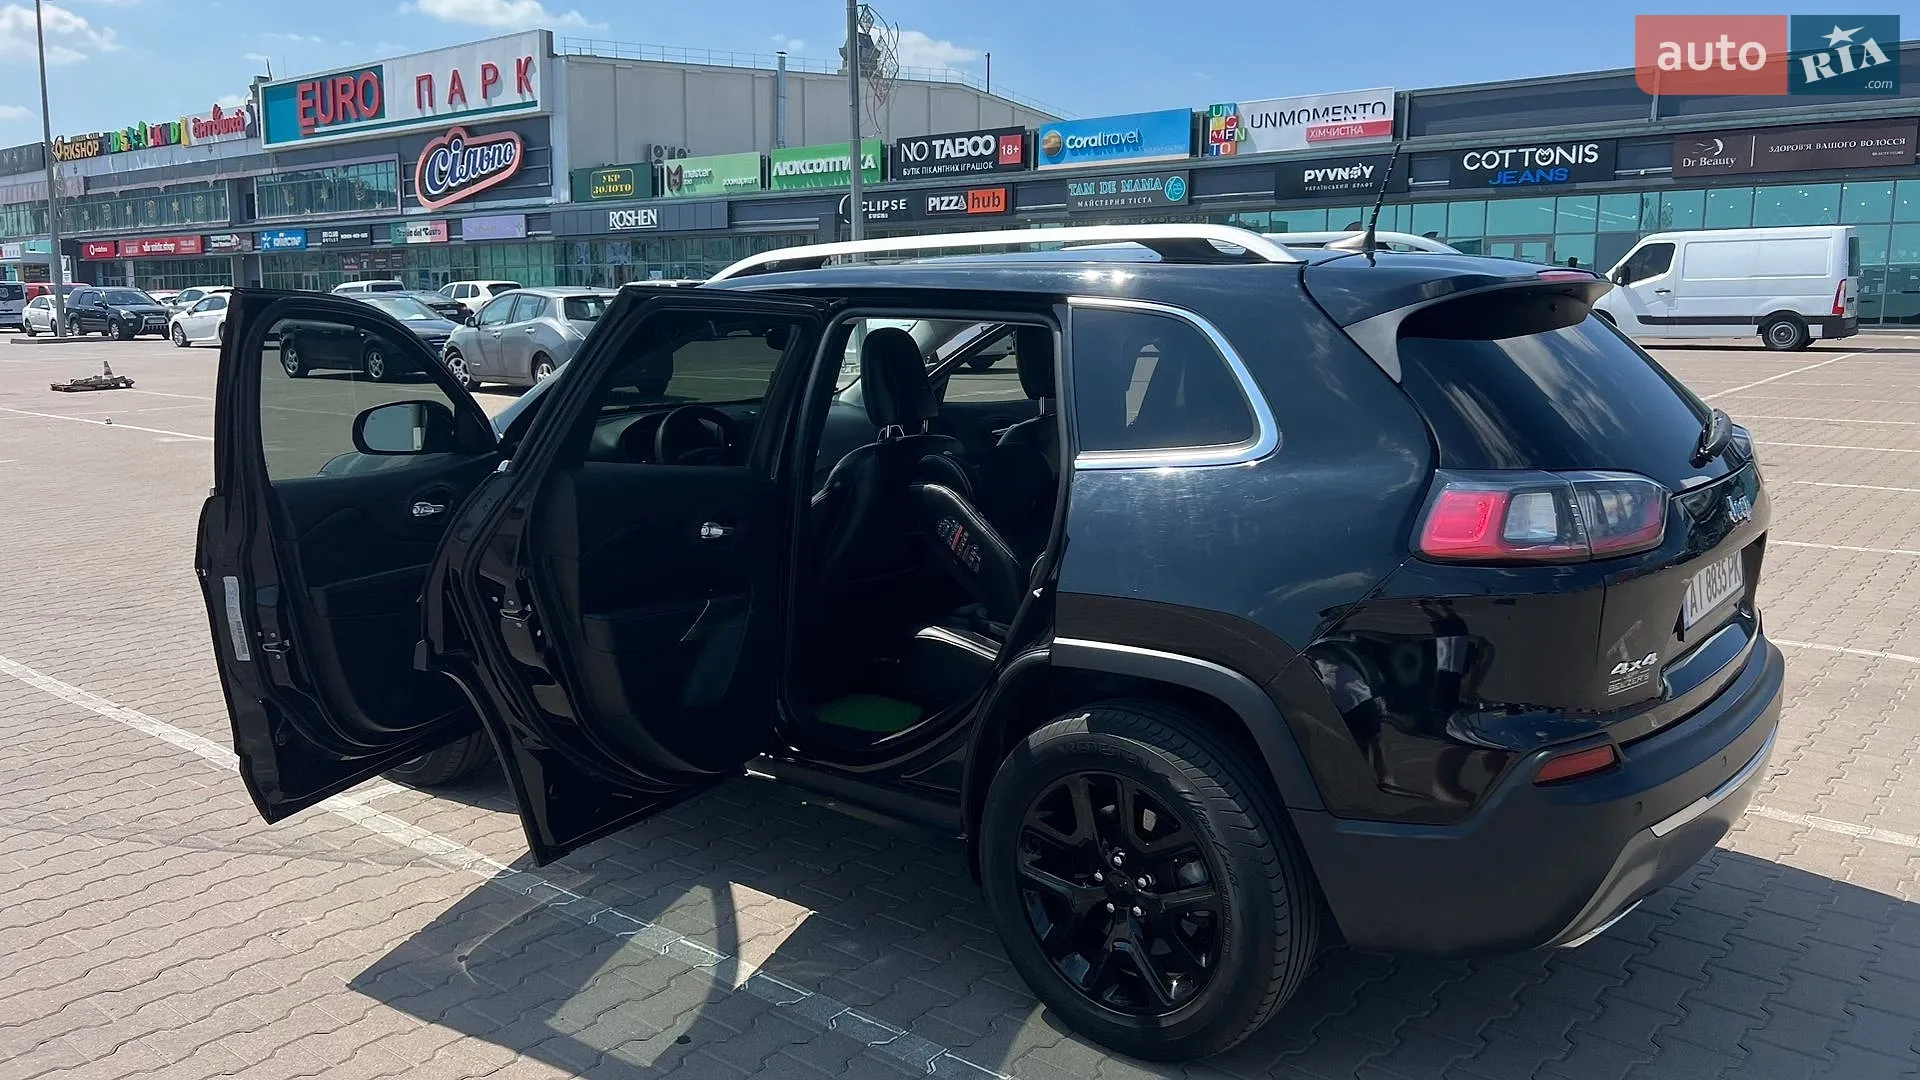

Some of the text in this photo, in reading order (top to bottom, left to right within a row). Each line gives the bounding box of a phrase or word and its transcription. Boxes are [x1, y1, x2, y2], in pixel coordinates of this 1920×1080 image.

[298, 56, 532, 126] EURO ПАРК
[1250, 101, 1387, 129] UNMOMENTO
[54, 140, 99, 161] ORKSHOP
[901, 134, 996, 162] NO TABOO
[1001, 144, 1019, 156] 18+
[1815, 140, 1857, 151] ВАШОГО
[1860, 137, 1906, 148] ВОЛОССЯ
[425, 138, 516, 195] Сільпо
[1463, 143, 1599, 170] COTTONIS
[1682, 156, 1737, 169] Dr Beauty
[602, 174, 621, 183] УКР
[1488, 167, 1569, 185] JEANS
[593, 184, 632, 194] ЗОЛОТО
[861, 199, 907, 212] CLIPSE
[928, 191, 1001, 212] PIZZA hub
[609, 208, 658, 230] ROSHEN
[1705, 560, 1727, 603] 8835
[1610, 653, 1658, 675] 4x4
